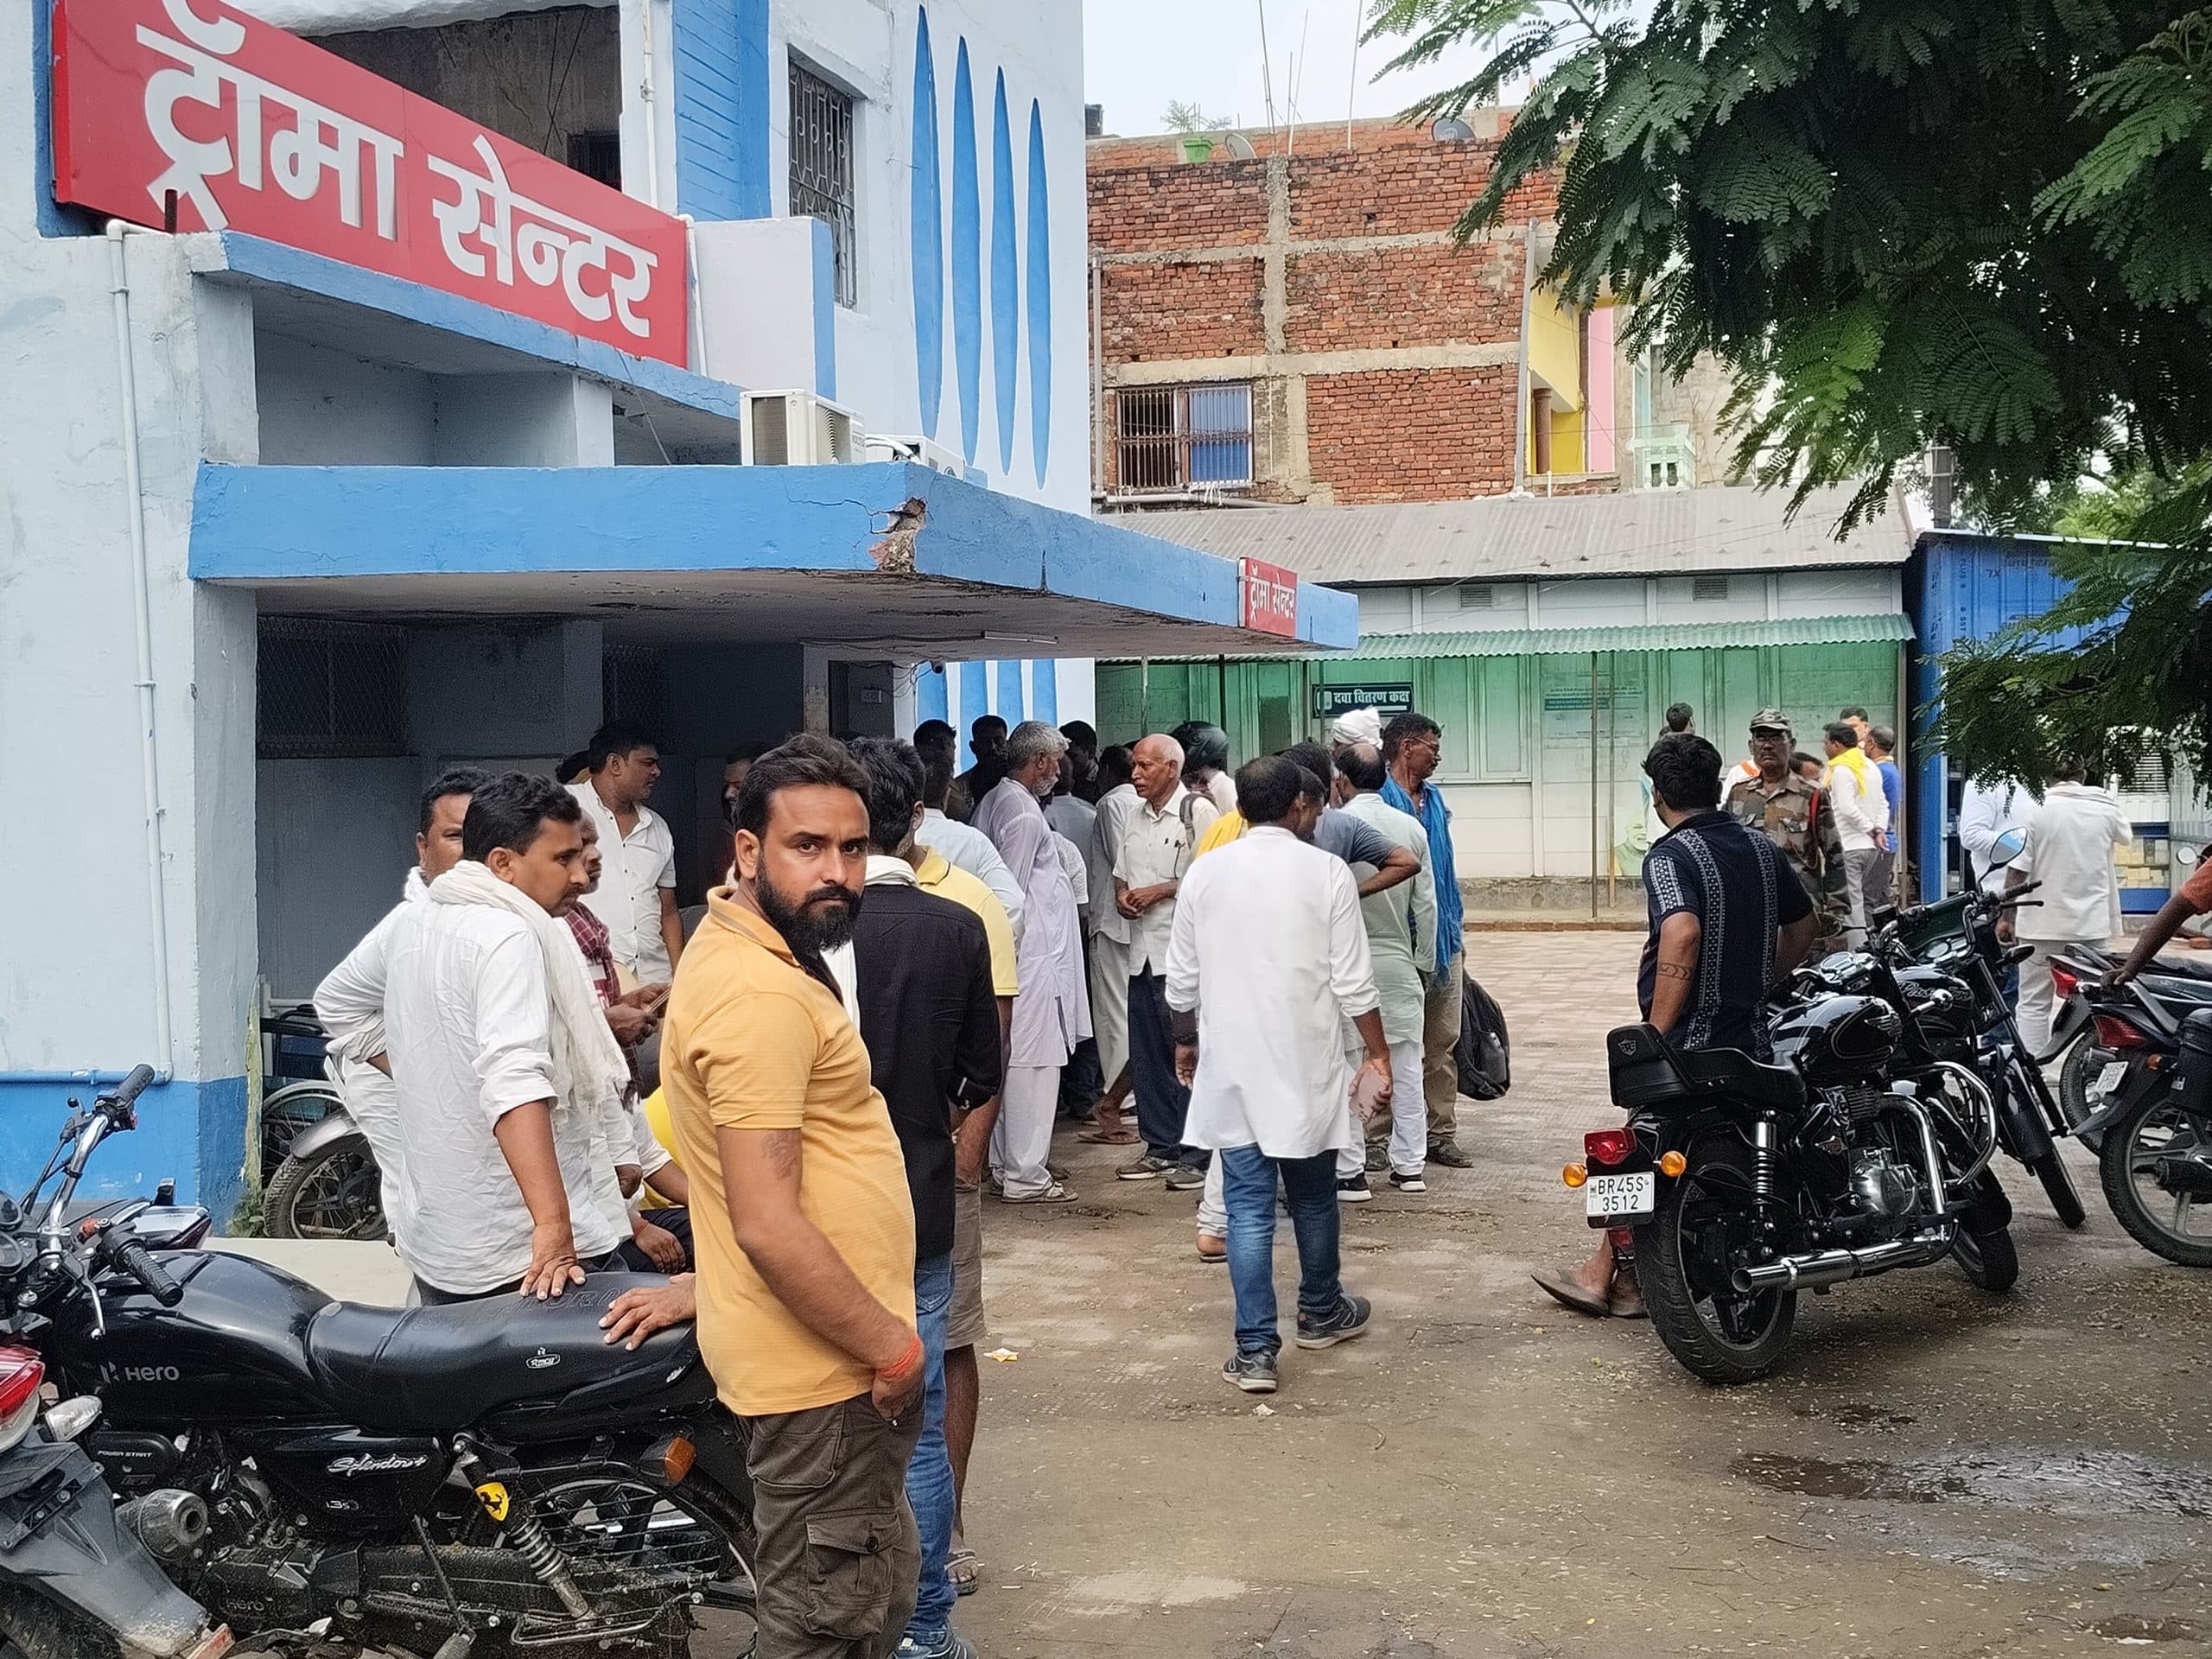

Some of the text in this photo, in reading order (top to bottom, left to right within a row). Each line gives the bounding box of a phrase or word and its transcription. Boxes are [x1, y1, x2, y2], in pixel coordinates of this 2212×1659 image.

[428, 135, 658, 338] सेन्टर
[1333, 692, 1352, 704] दवा
[1353, 689, 1388, 703] वितरण
[1598, 1176, 1644, 1195] BR45S
[1602, 1194, 1638, 1211] 3512
[124, 1366, 180, 1381] Hero
